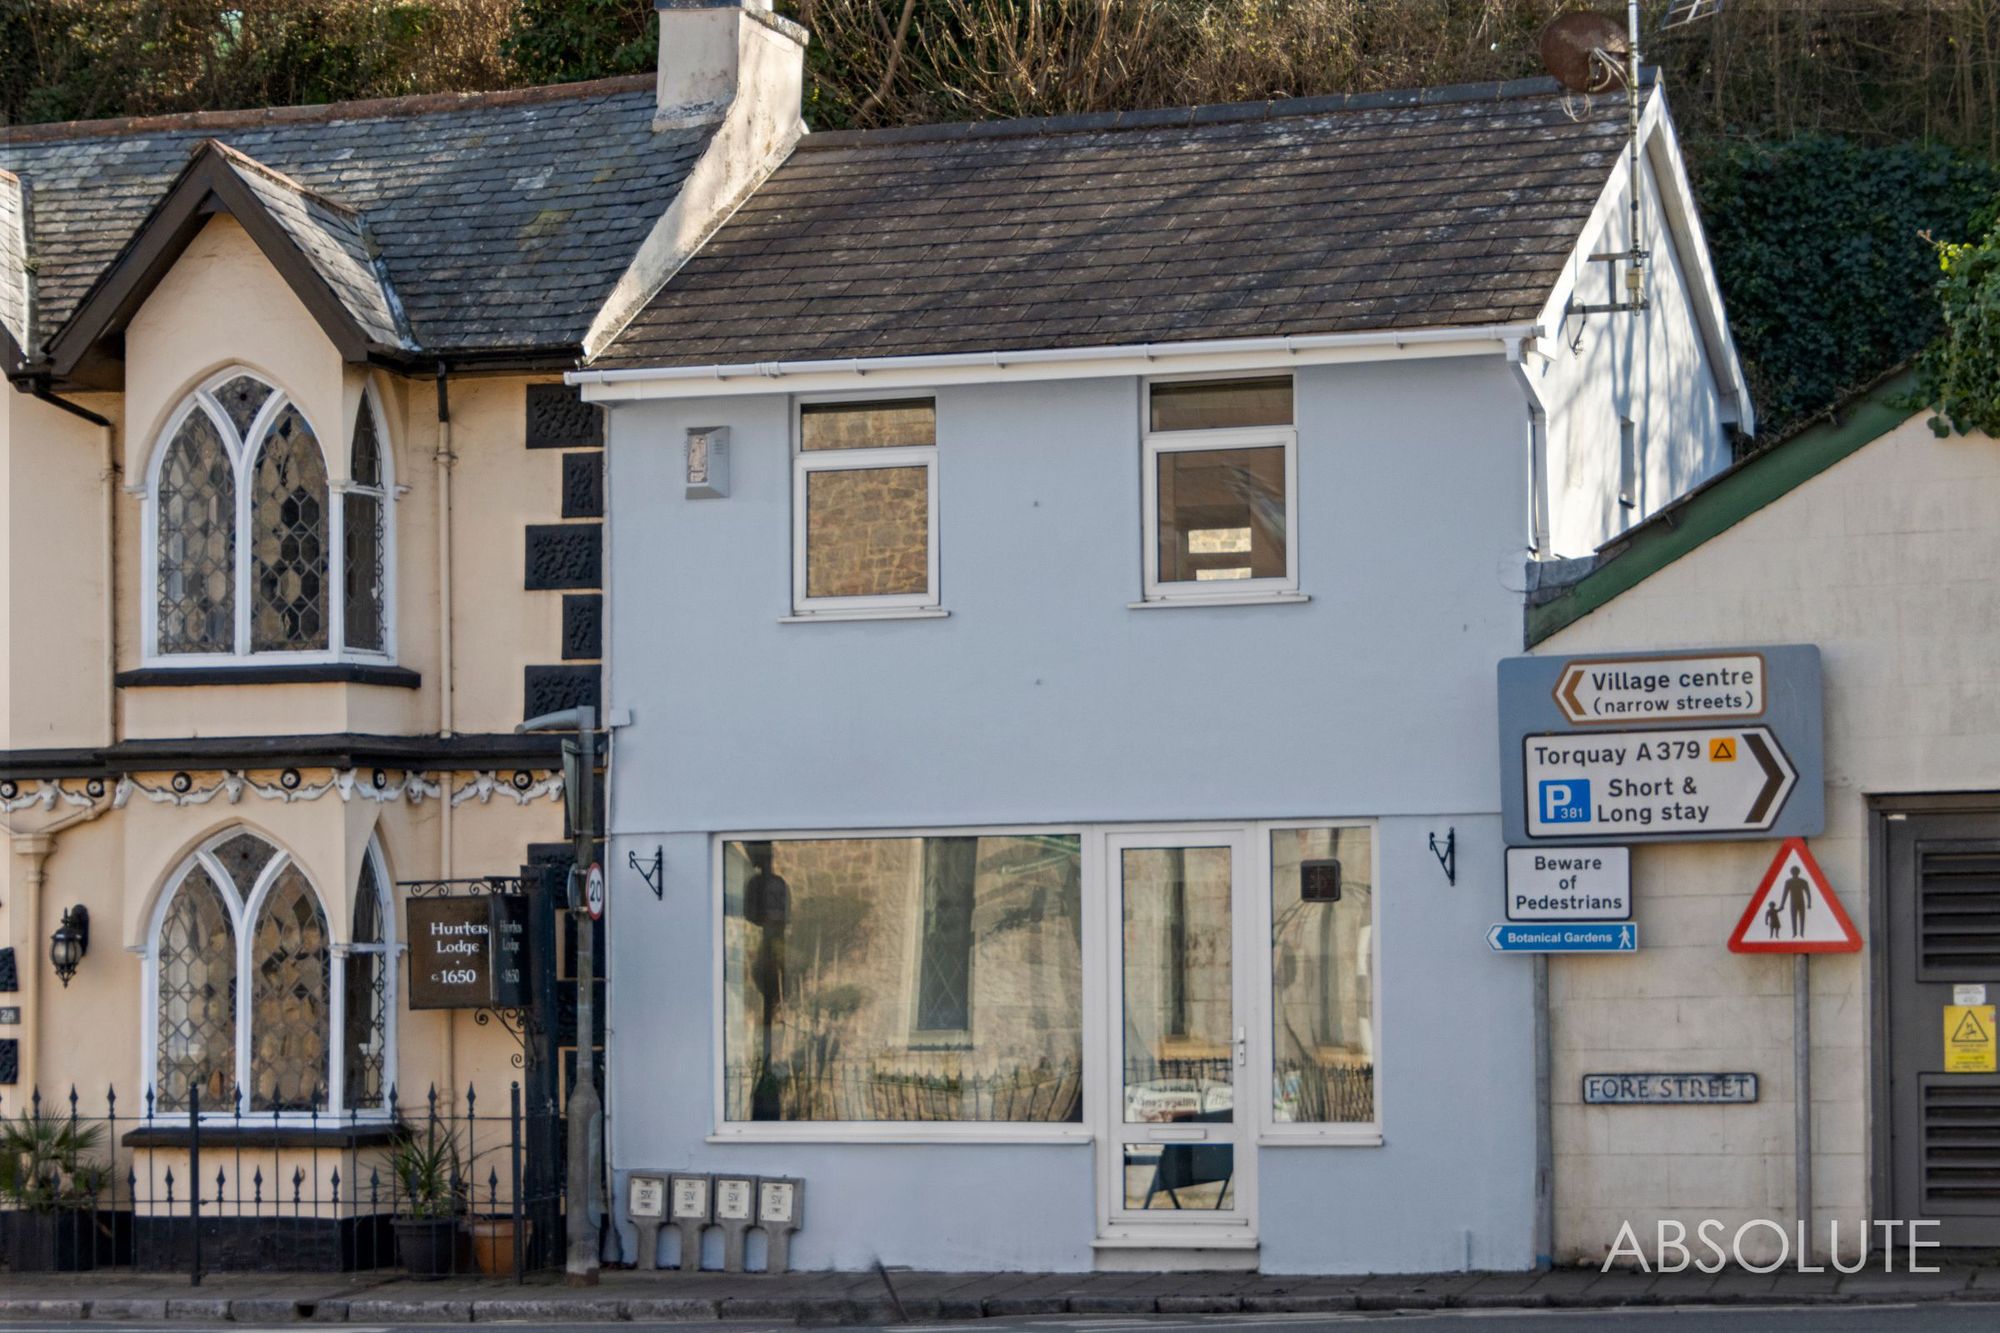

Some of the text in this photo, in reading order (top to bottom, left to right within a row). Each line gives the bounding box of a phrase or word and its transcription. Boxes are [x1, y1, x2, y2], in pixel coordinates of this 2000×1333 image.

[1592, 668, 1754, 692] Village centre
[1593, 690, 1754, 716] (narrow streets)
[1534, 746, 1627, 767] Torquay
[1608, 776, 1698, 797] Short &
[1560, 807, 1583, 820] 381
[1598, 802, 1710, 825] Long stay
[1534, 856, 1602, 870] Beware
[590, 880, 601, 902] 20
[1559, 875, 1577, 890] of
[1516, 894, 1623, 910] Pedestrians
[431, 922, 489, 935] Hunters
[1508, 932, 1613, 943] Botanical Gardens
[437, 940, 480, 956] Lodge
[1589, 1078, 1749, 1098] FORE STREET
